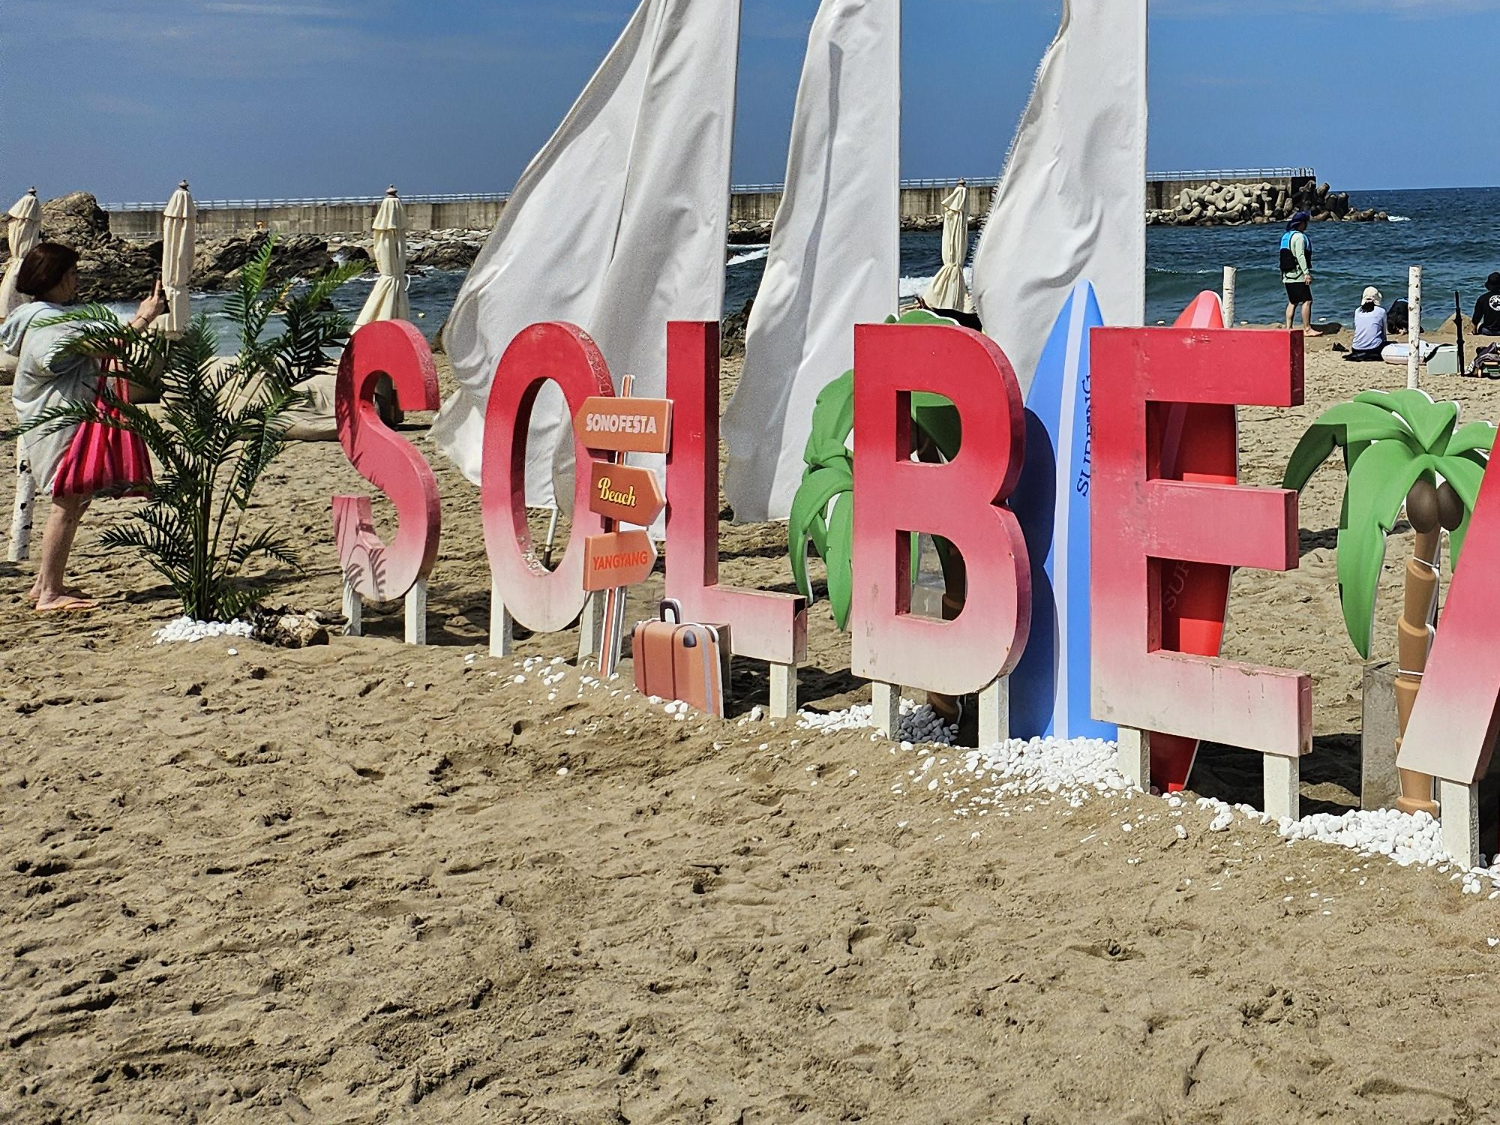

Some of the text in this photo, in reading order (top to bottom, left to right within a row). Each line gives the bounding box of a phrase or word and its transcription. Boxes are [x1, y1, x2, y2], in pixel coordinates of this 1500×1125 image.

[585, 413, 657, 434] SONOFESTA
[597, 477, 637, 508] Beach
[592, 550, 649, 571] YANGYANG
